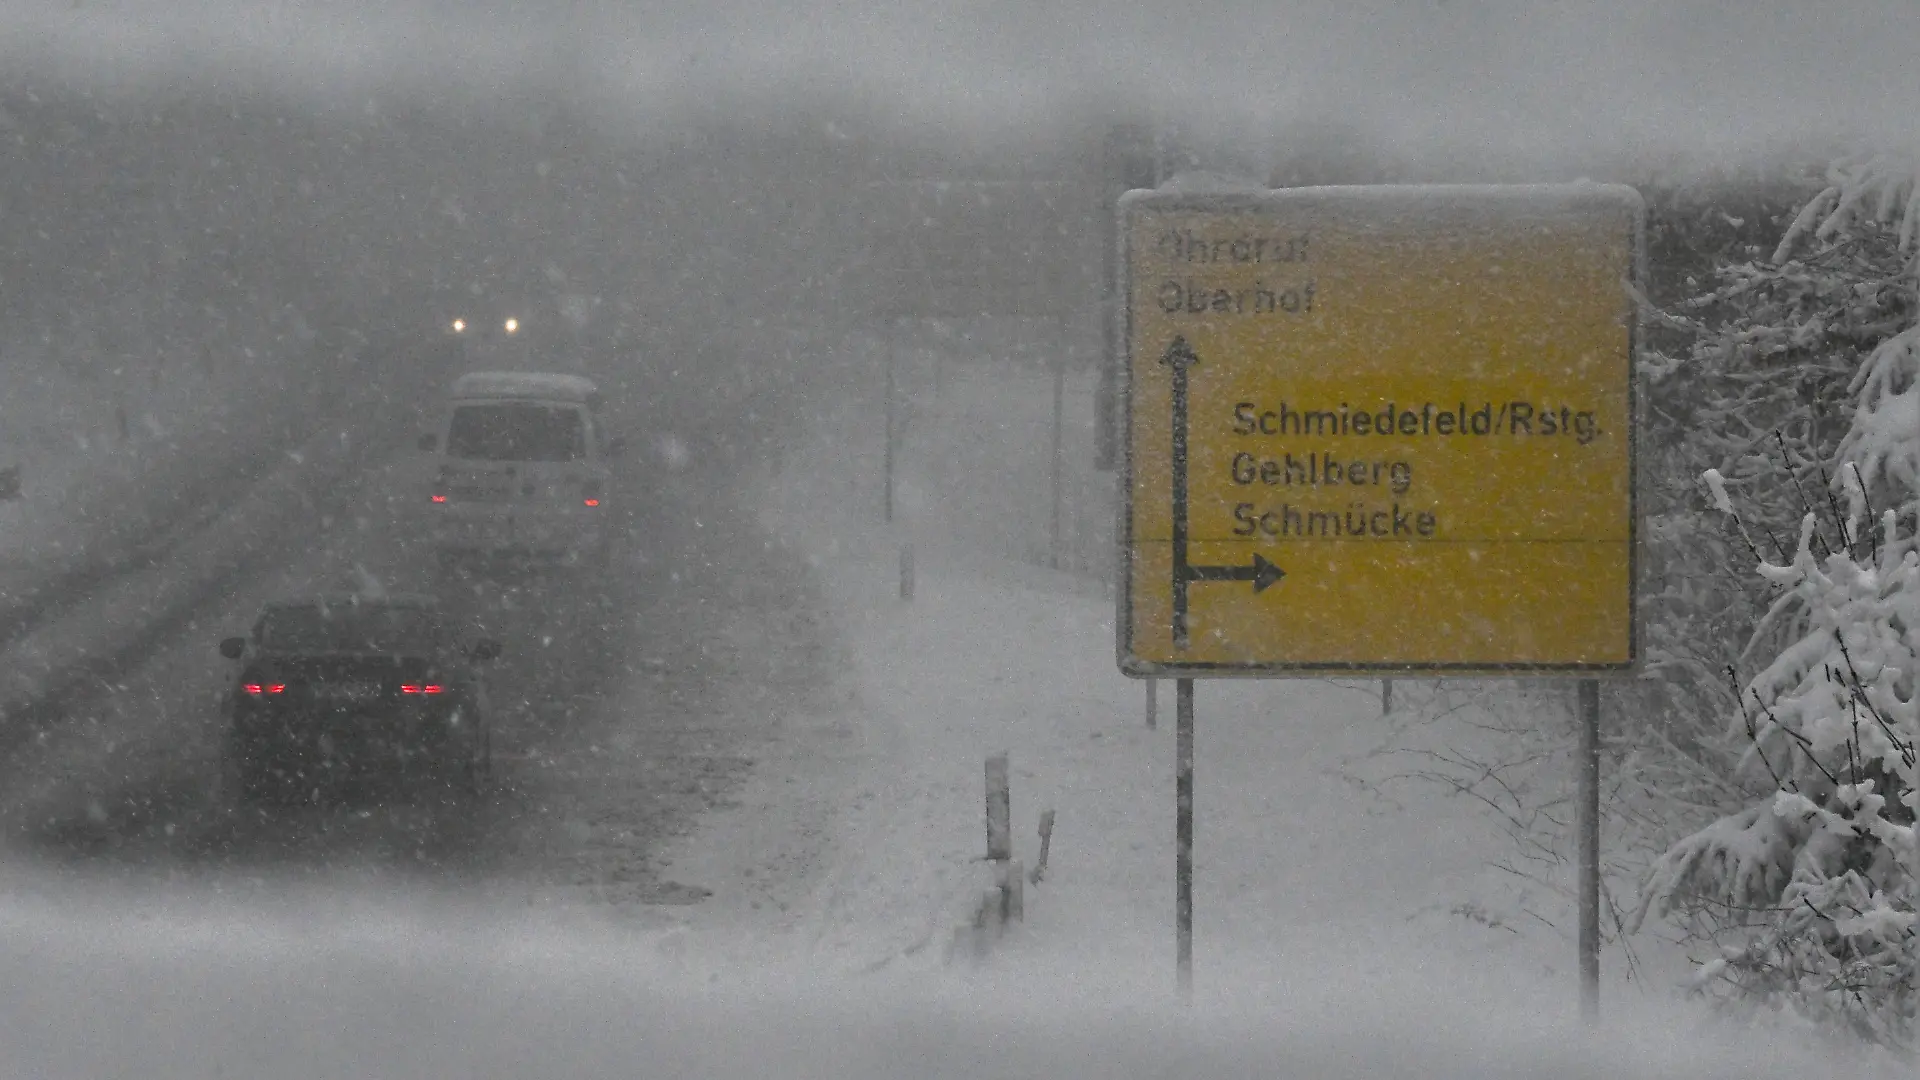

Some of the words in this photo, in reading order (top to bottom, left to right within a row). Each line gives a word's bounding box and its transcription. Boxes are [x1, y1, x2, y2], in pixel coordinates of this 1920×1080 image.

[1232, 402, 1603, 444] Schmiedefeld/Rstg.
[1231, 451, 1412, 494] Gehlberg
[1232, 502, 1437, 537] Schmücke
